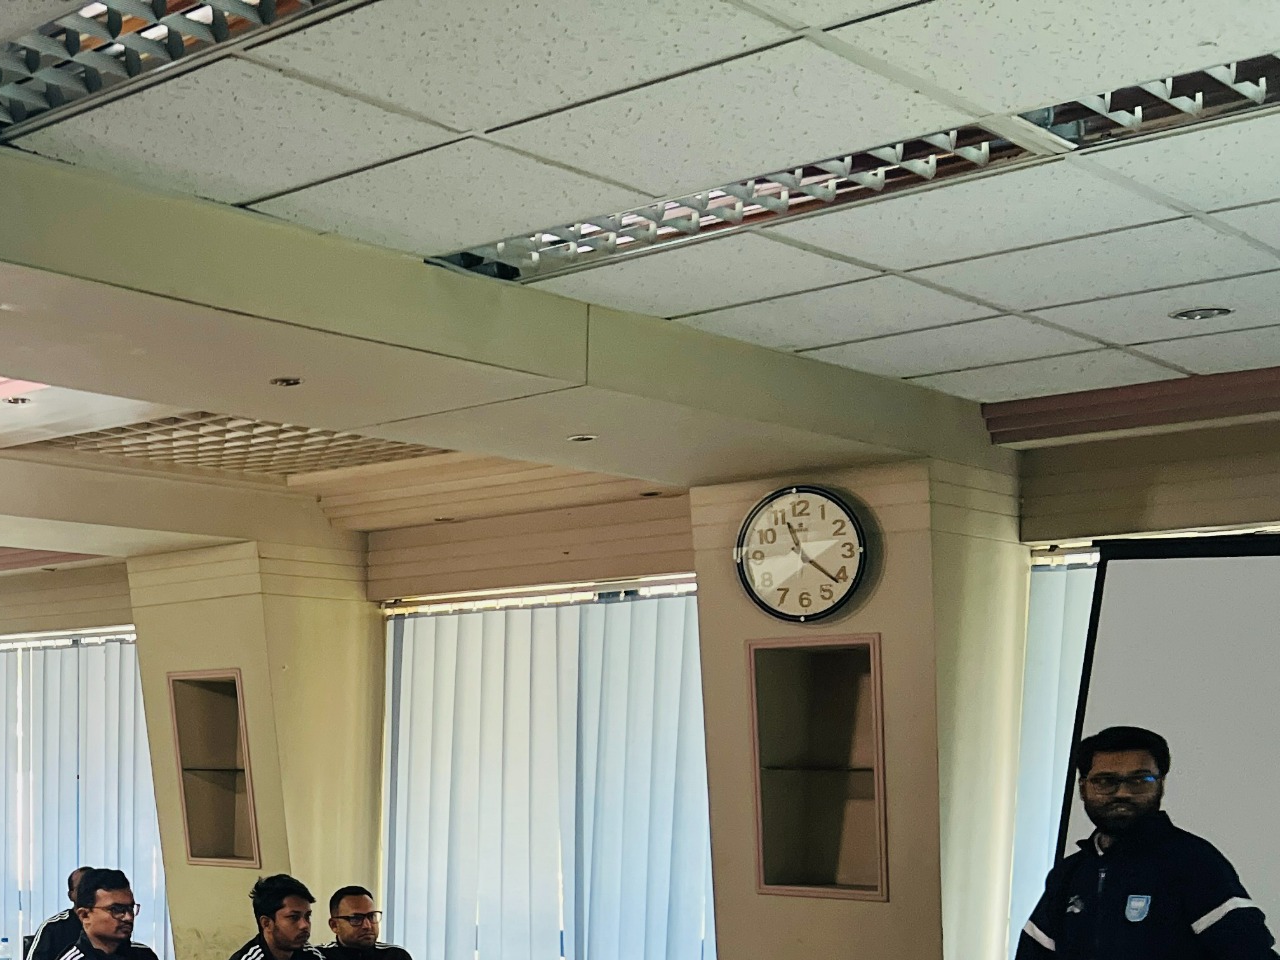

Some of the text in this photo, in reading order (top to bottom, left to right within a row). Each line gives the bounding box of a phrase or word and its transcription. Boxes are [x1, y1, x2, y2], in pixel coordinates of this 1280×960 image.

[771, 509, 786, 525] 11
[789, 500, 810, 517] 12
[818, 504, 826, 520] 1
[832, 519, 846, 536] 2
[757, 528, 777, 545] 10
[751, 550, 765, 566] 9
[841, 542, 855, 559] 3
[761, 572, 773, 588] 8
[836, 565, 848, 583] 4
[776, 587, 790, 607] 7
[798, 592, 812, 608] 6
[820, 584, 834, 601] 5
